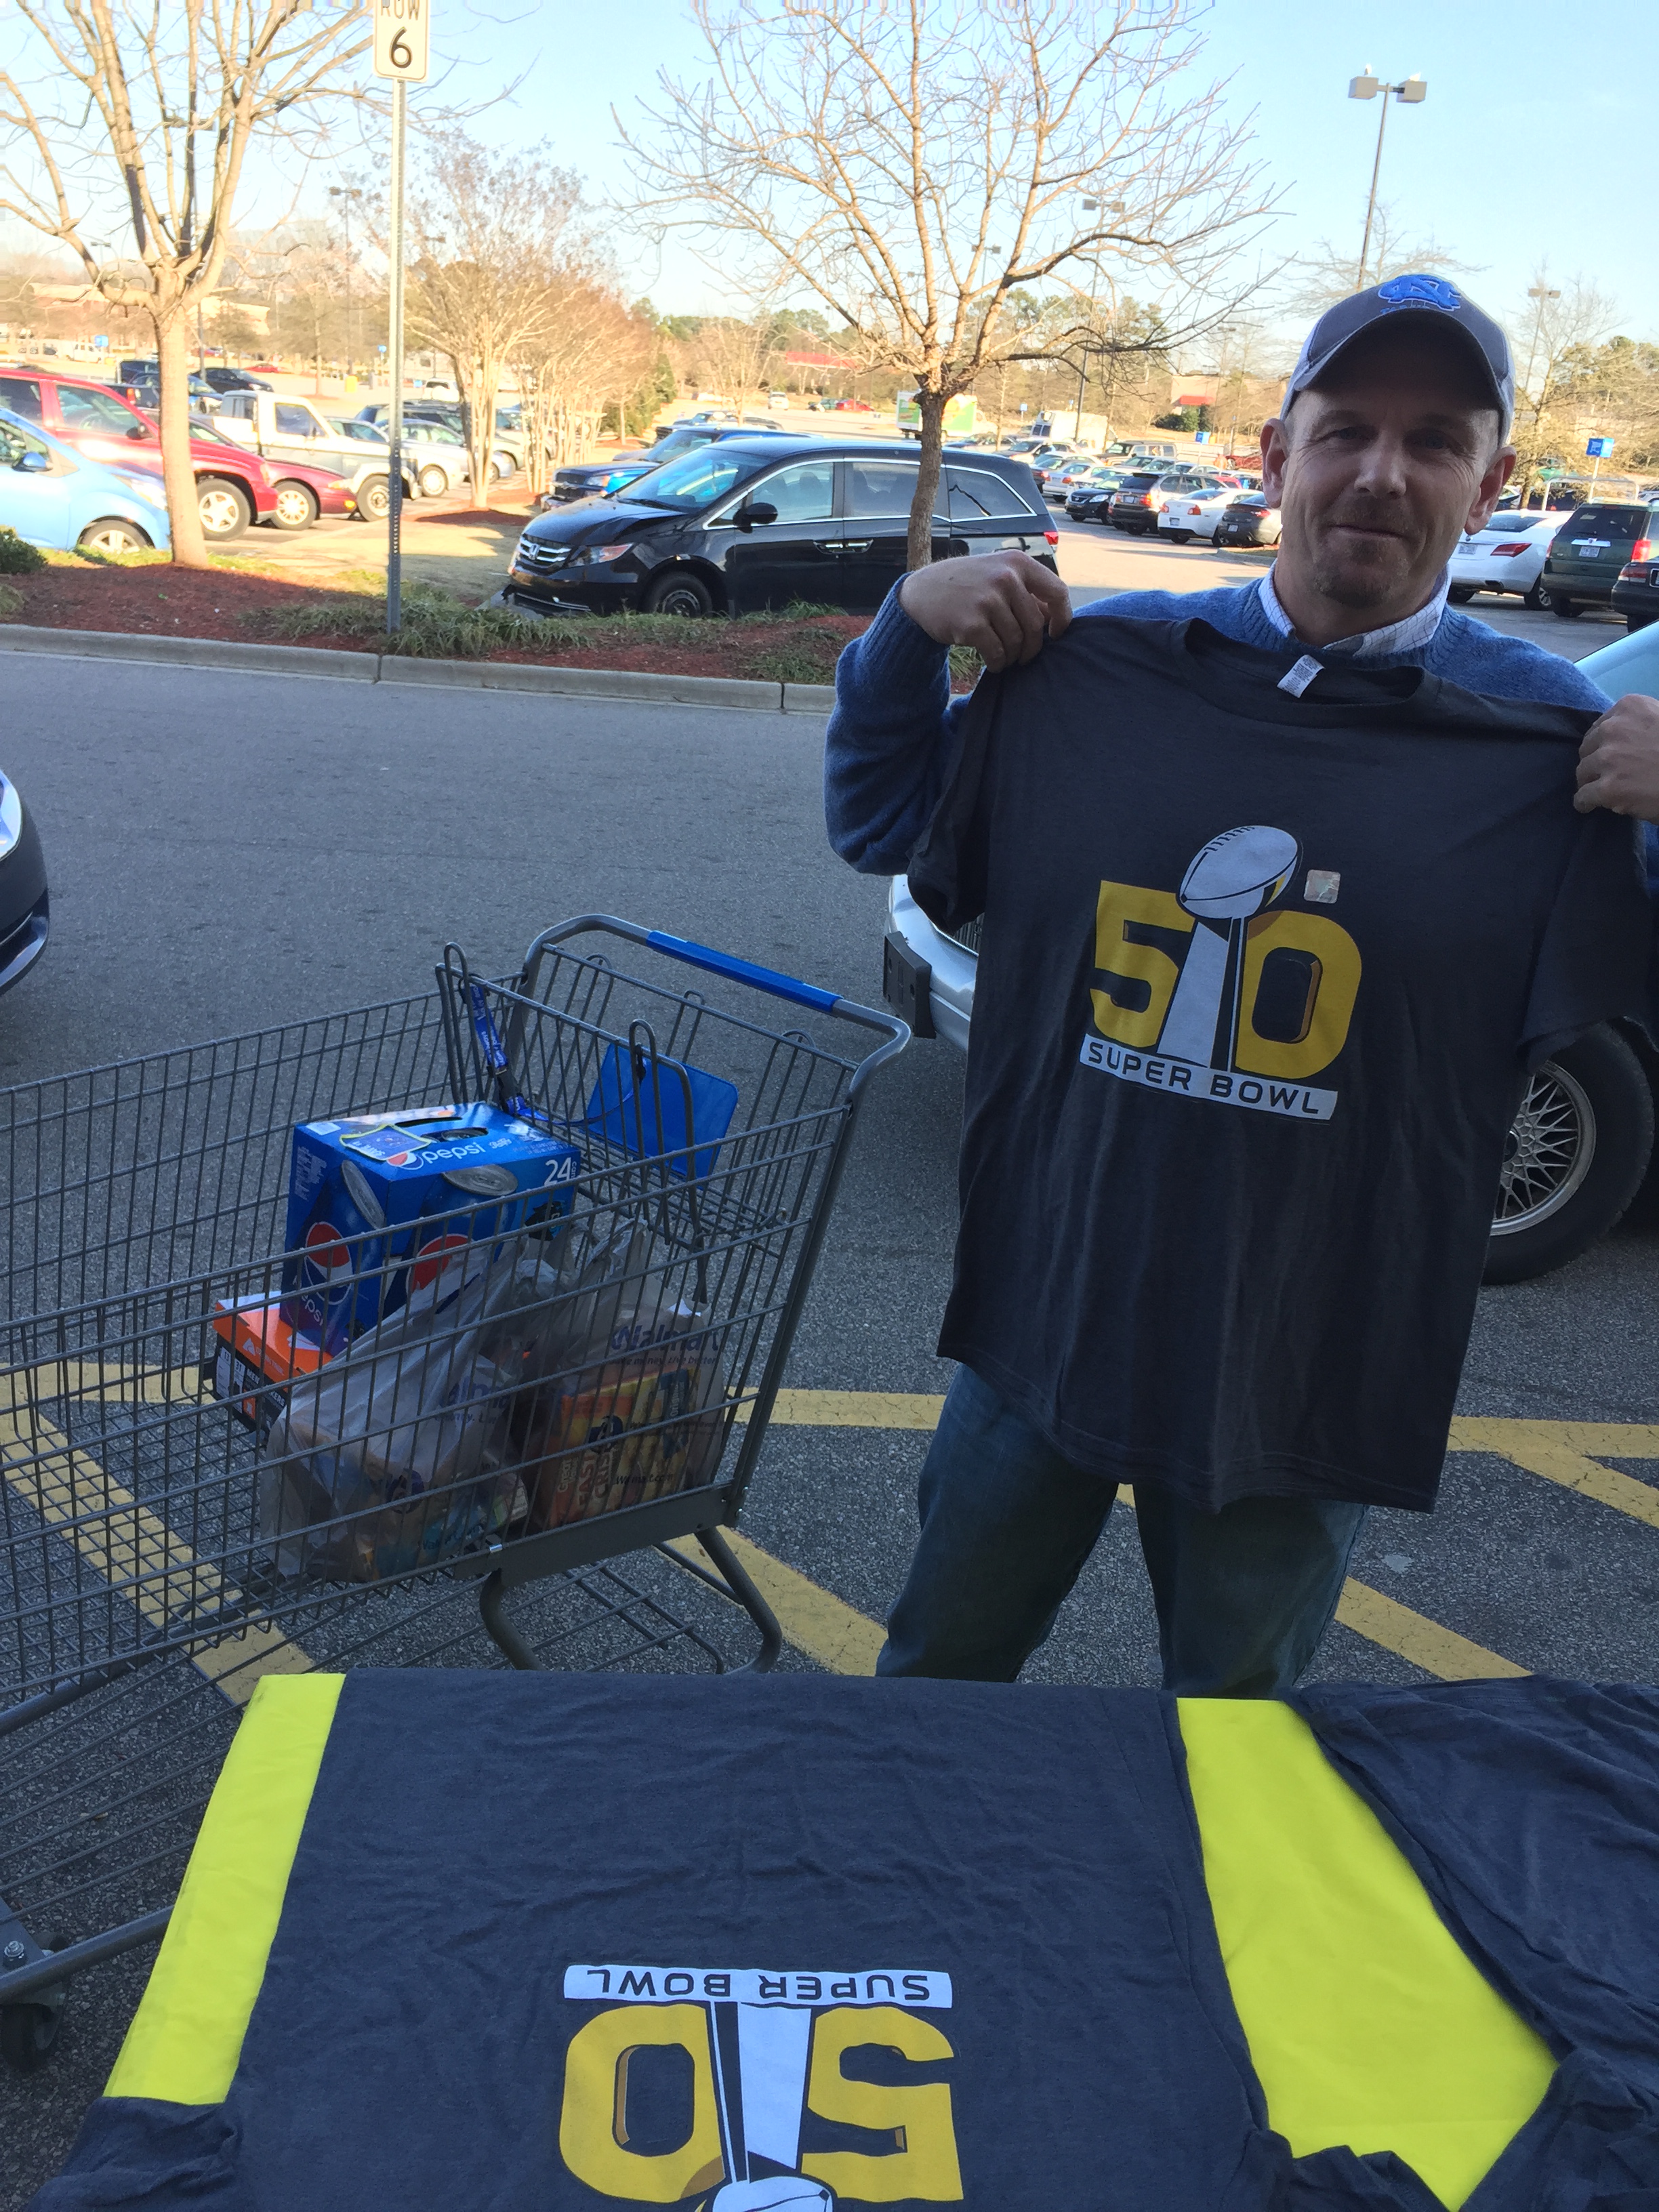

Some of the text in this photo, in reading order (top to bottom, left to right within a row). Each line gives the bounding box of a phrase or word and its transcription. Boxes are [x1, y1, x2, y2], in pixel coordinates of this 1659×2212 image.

[389, 26, 413, 69] 6
[1088, 1041, 1319, 1115] SUPER BOWL
[422, 1141, 487, 1164] pepsi
[544, 1157, 573, 1186] 24
[587, 1969, 930, 2001] SUPER BOWL
